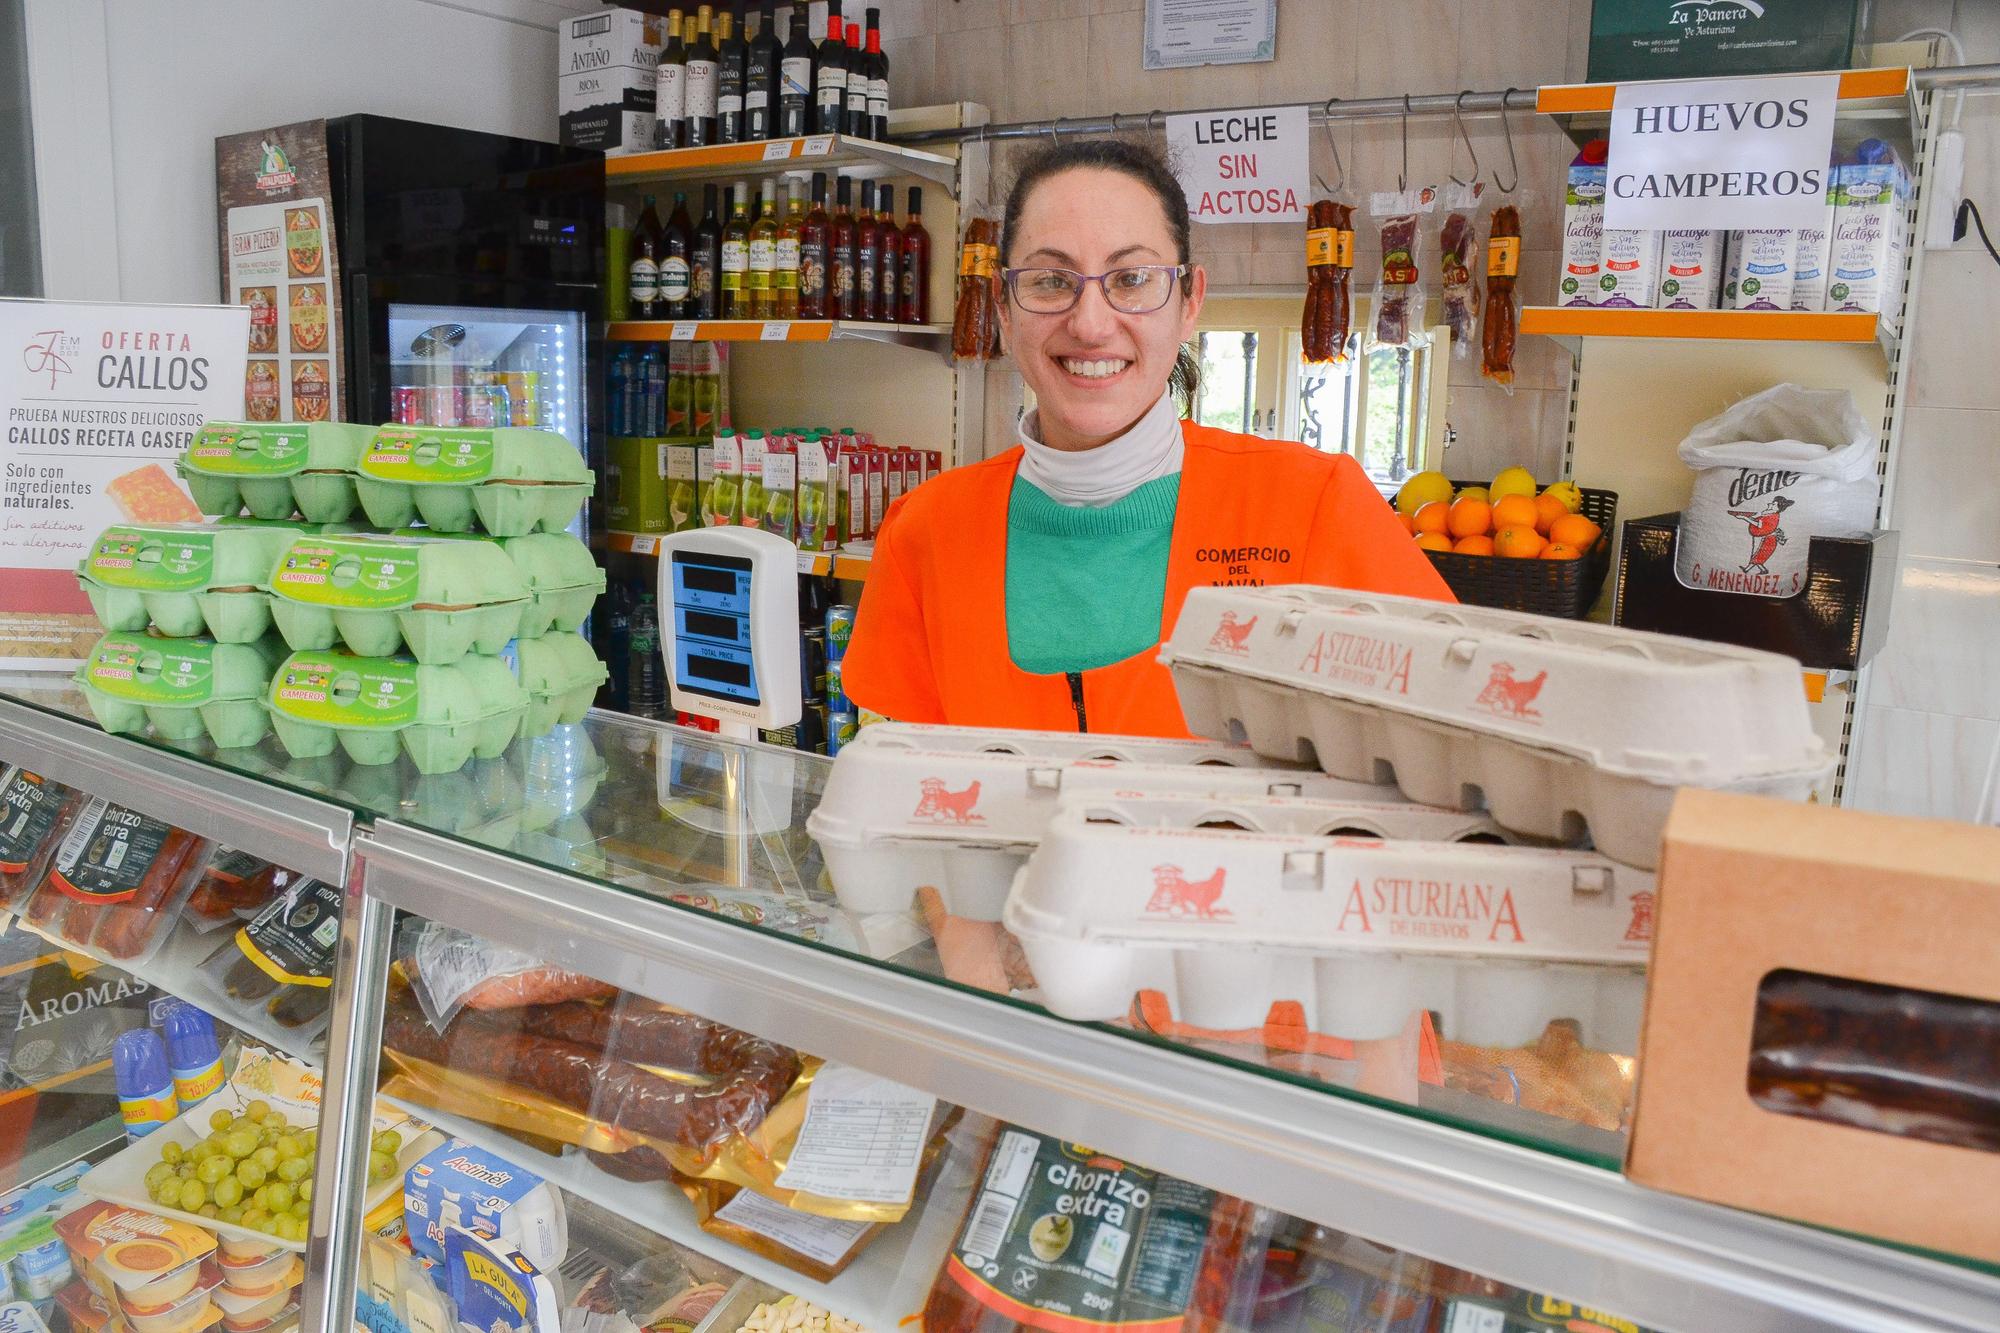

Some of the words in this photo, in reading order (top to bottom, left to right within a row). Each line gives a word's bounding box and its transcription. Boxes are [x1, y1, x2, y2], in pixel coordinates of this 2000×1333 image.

[1669, 10, 1688, 24] La
[1696, 8, 1747, 25] Panera
[571, 48, 610, 71] ANTAÑO
[1633, 99, 1809, 135] HUEVOS
[1195, 116, 1278, 145] LECHE
[1218, 154, 1257, 179] SIN
[1613, 169, 1820, 199] CAMPEROS
[1189, 189, 1299, 215] ACTOSA
[1863, 214, 1880, 226] sin
[1837, 224, 1881, 242] lactosa
[102, 331, 191, 352] OFERTA
[98, 355, 209, 391] CALLOS
[9, 408, 58, 423] PRUEBA
[62, 410, 127, 425] NUESTROS
[131, 412, 204, 427] DELICIOSOS
[8, 427, 70, 445] CALLOS
[76, 429, 135, 447] RECETA
[6, 463, 36, 478] Solo
[40, 466, 64, 479] con
[5, 479, 92, 495] ingredientes
[3, 494, 74, 510] naturales.
[3, 516, 23, 531] Sin
[30, 518, 85, 531] aditivos
[1195, 547, 1291, 563] COMERCIO
[281, 573, 327, 584] CAMPEROS
[1228, 565, 1250, 575] DEL
[701, 648, 717, 657] TOTAL
[718, 651, 734, 660] PRICE
[1300, 631, 1414, 695] ASTURIANA
[281, 689, 326, 702] CAMPEROS
[5, 789, 33, 812] extra
[1337, 878, 1526, 942] ASTURIANA
[1411, 922, 1470, 940] HUEVOS
[14, 975, 149, 1031] AROMAS
[443, 1157, 512, 1188] Actimel
[1047, 1163, 1151, 1209] chorizo
[1056, 1194, 1126, 1226] extra
[471, 1259, 487, 1276] LA
[490, 1268, 520, 1303] GULA
[483, 1286, 494, 1299] DEL
